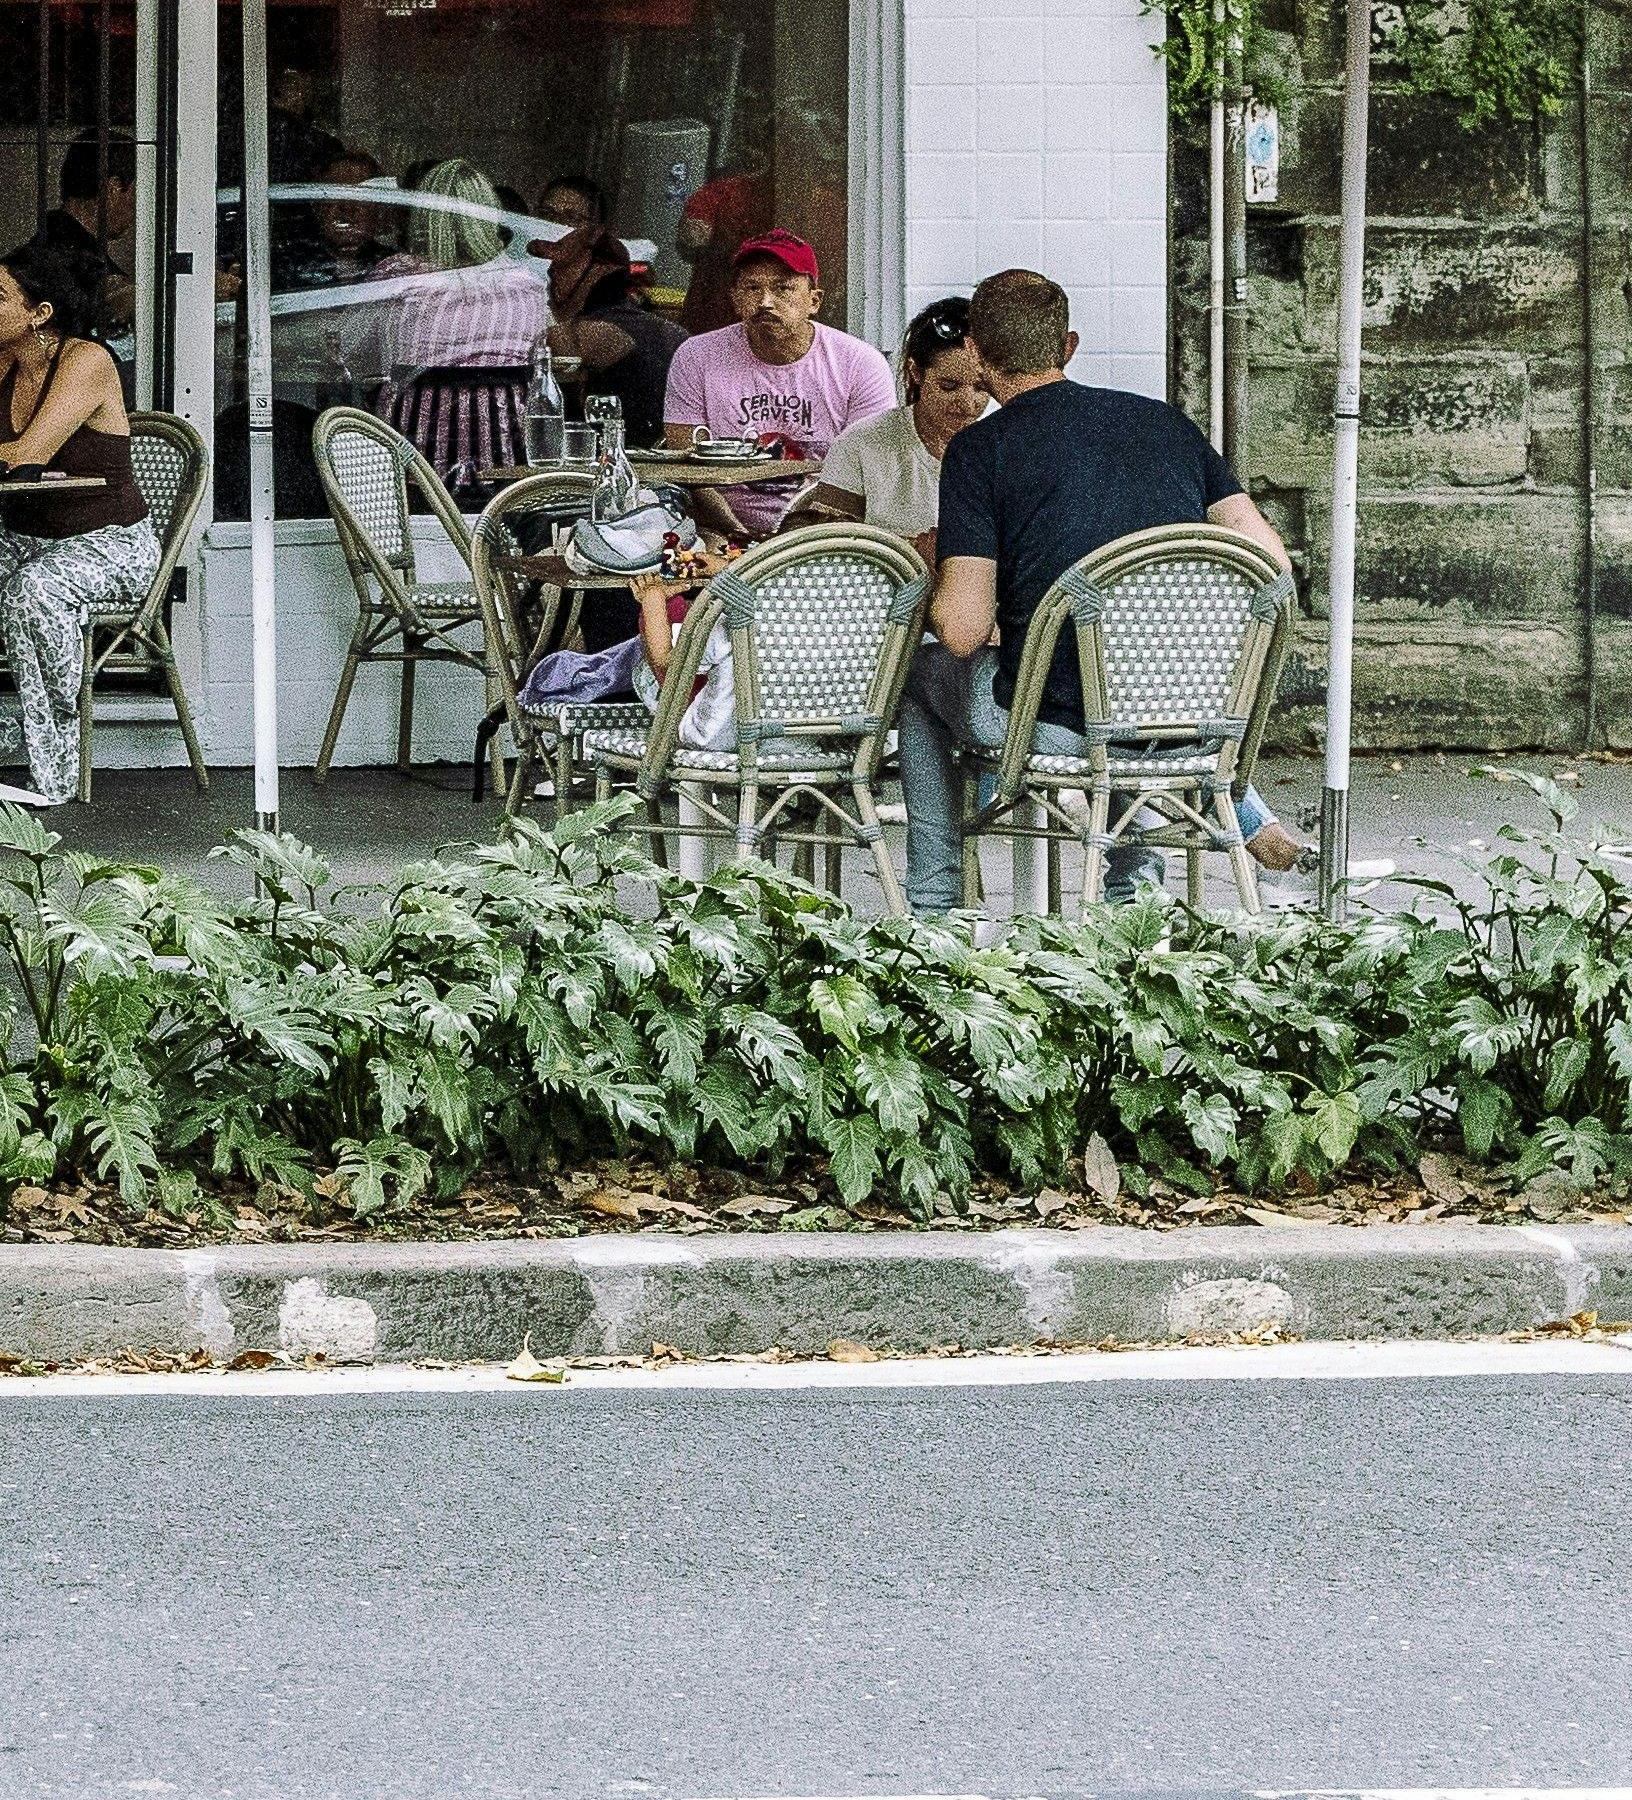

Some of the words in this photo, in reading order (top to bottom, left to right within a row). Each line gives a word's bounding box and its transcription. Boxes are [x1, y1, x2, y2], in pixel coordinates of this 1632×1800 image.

[738, 393, 769, 426] SEA
[775, 394, 813, 428] LION
[751, 407, 801, 423] CAVES
